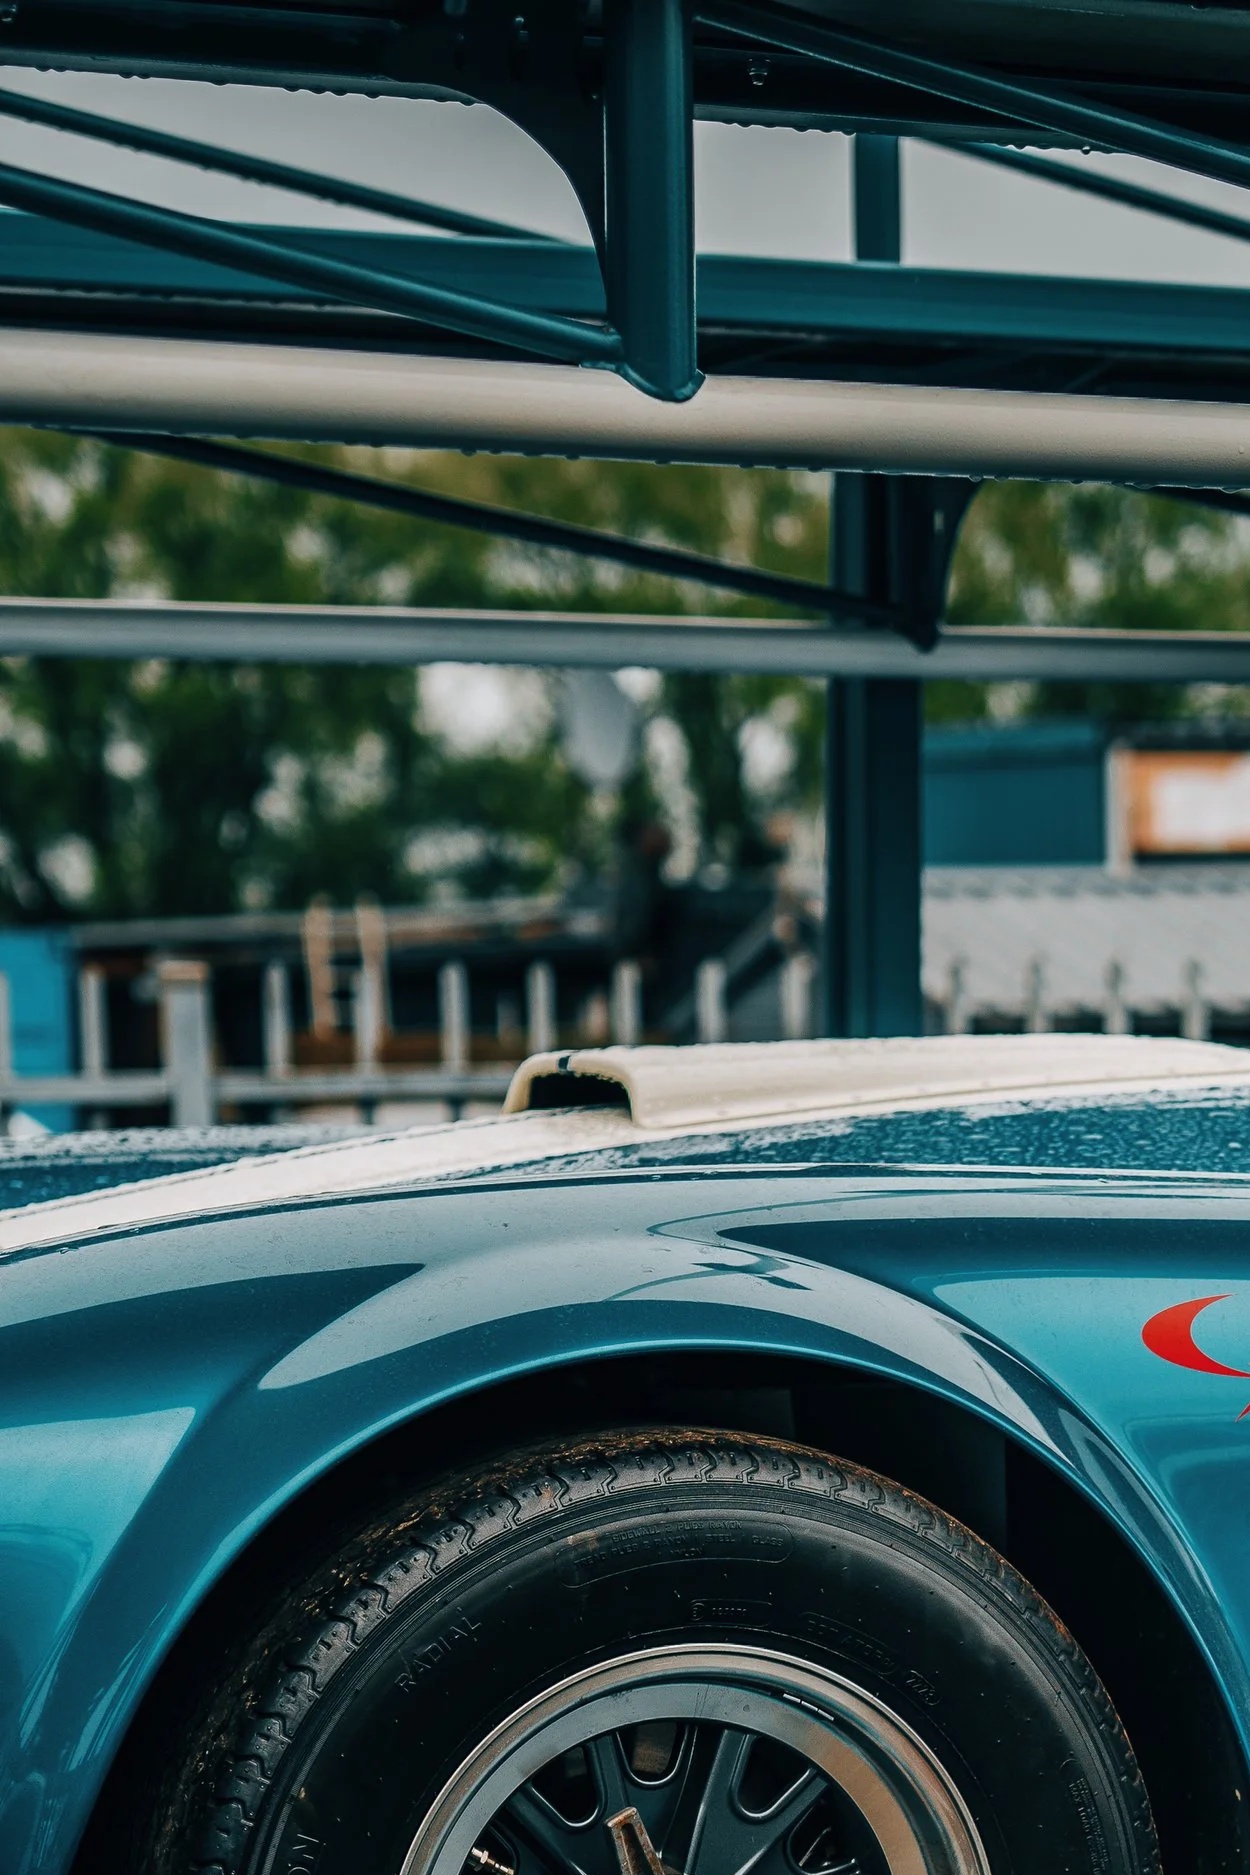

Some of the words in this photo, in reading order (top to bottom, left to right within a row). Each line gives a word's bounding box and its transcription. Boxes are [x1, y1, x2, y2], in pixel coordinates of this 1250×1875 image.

[612, 1527, 661, 1543] SIDEWALL
[709, 1520, 742, 1530] RAYON
[705, 1533, 735, 1543] STEEL
[394, 1616, 483, 1695] RADIAL
